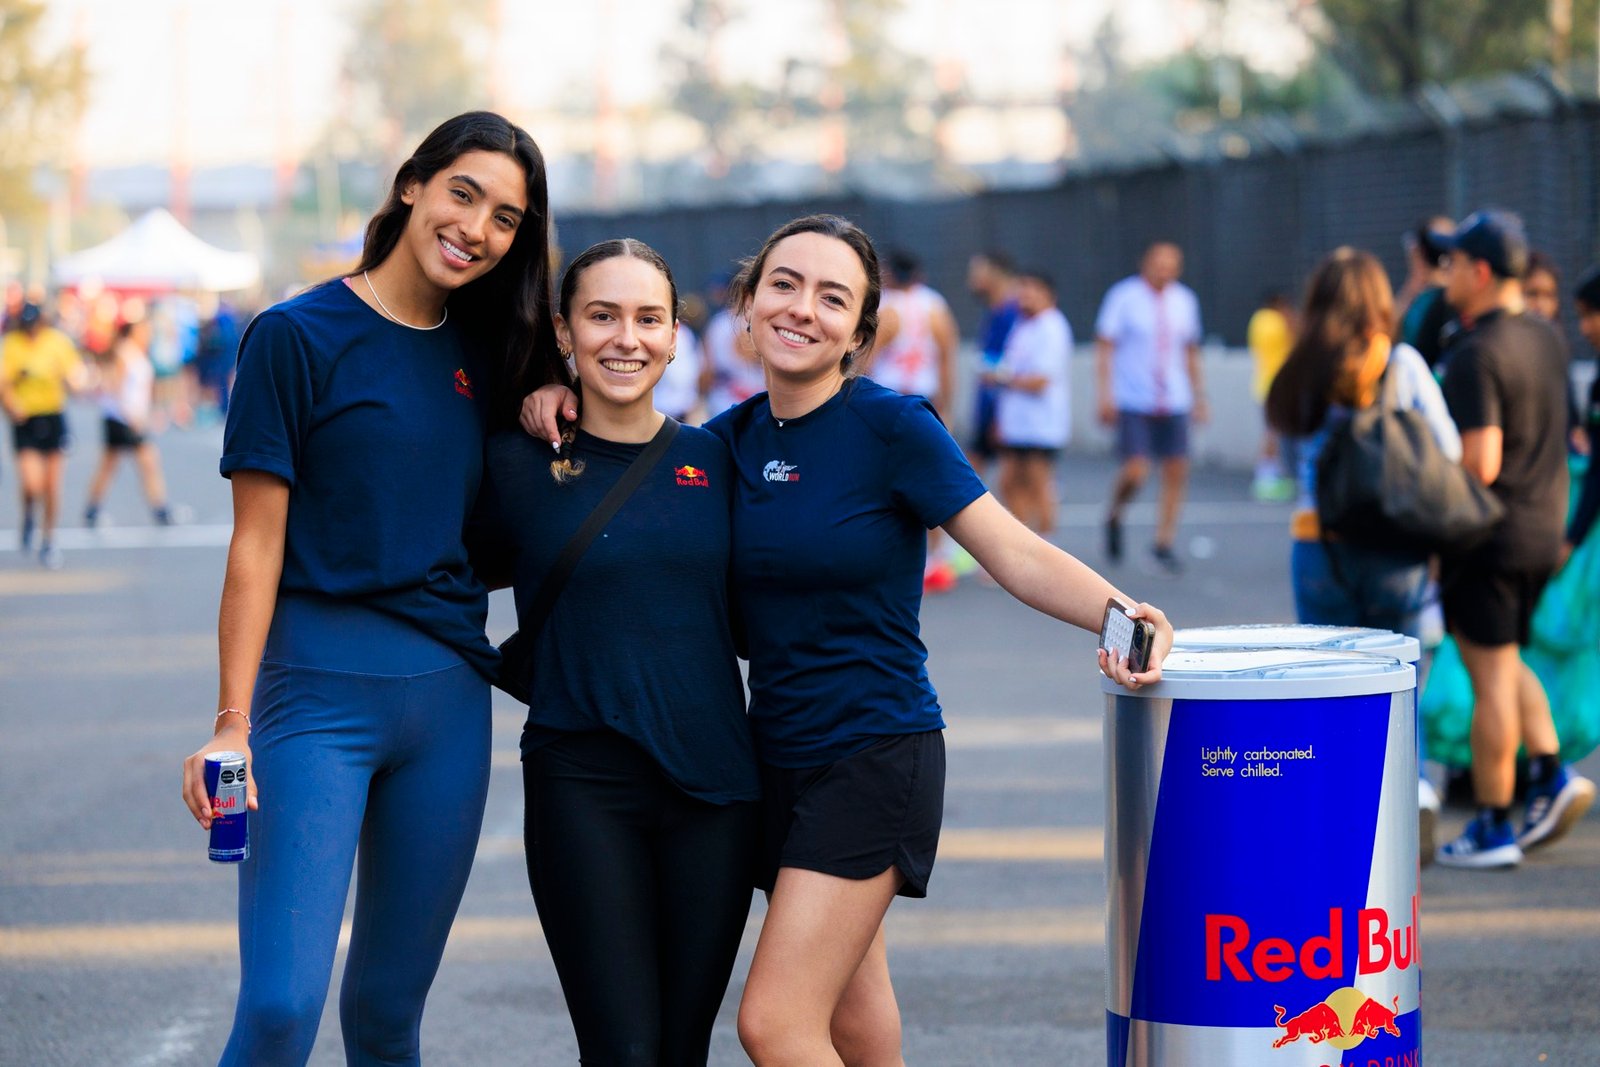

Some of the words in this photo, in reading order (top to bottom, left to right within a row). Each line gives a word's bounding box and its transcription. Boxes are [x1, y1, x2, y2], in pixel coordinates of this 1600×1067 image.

[676, 477, 694, 486] Red
[694, 477, 709, 487] Bull
[769, 472, 790, 483] WORLD
[1201, 745, 1238, 764] Lightly
[1243, 745, 1316, 761] carbonated.
[1201, 763, 1235, 777] Serve
[1240, 762, 1284, 777] chilled.
[213, 797, 235, 808] Bull
[1205, 907, 1342, 982] Red
[1358, 896, 1418, 976] Bul
